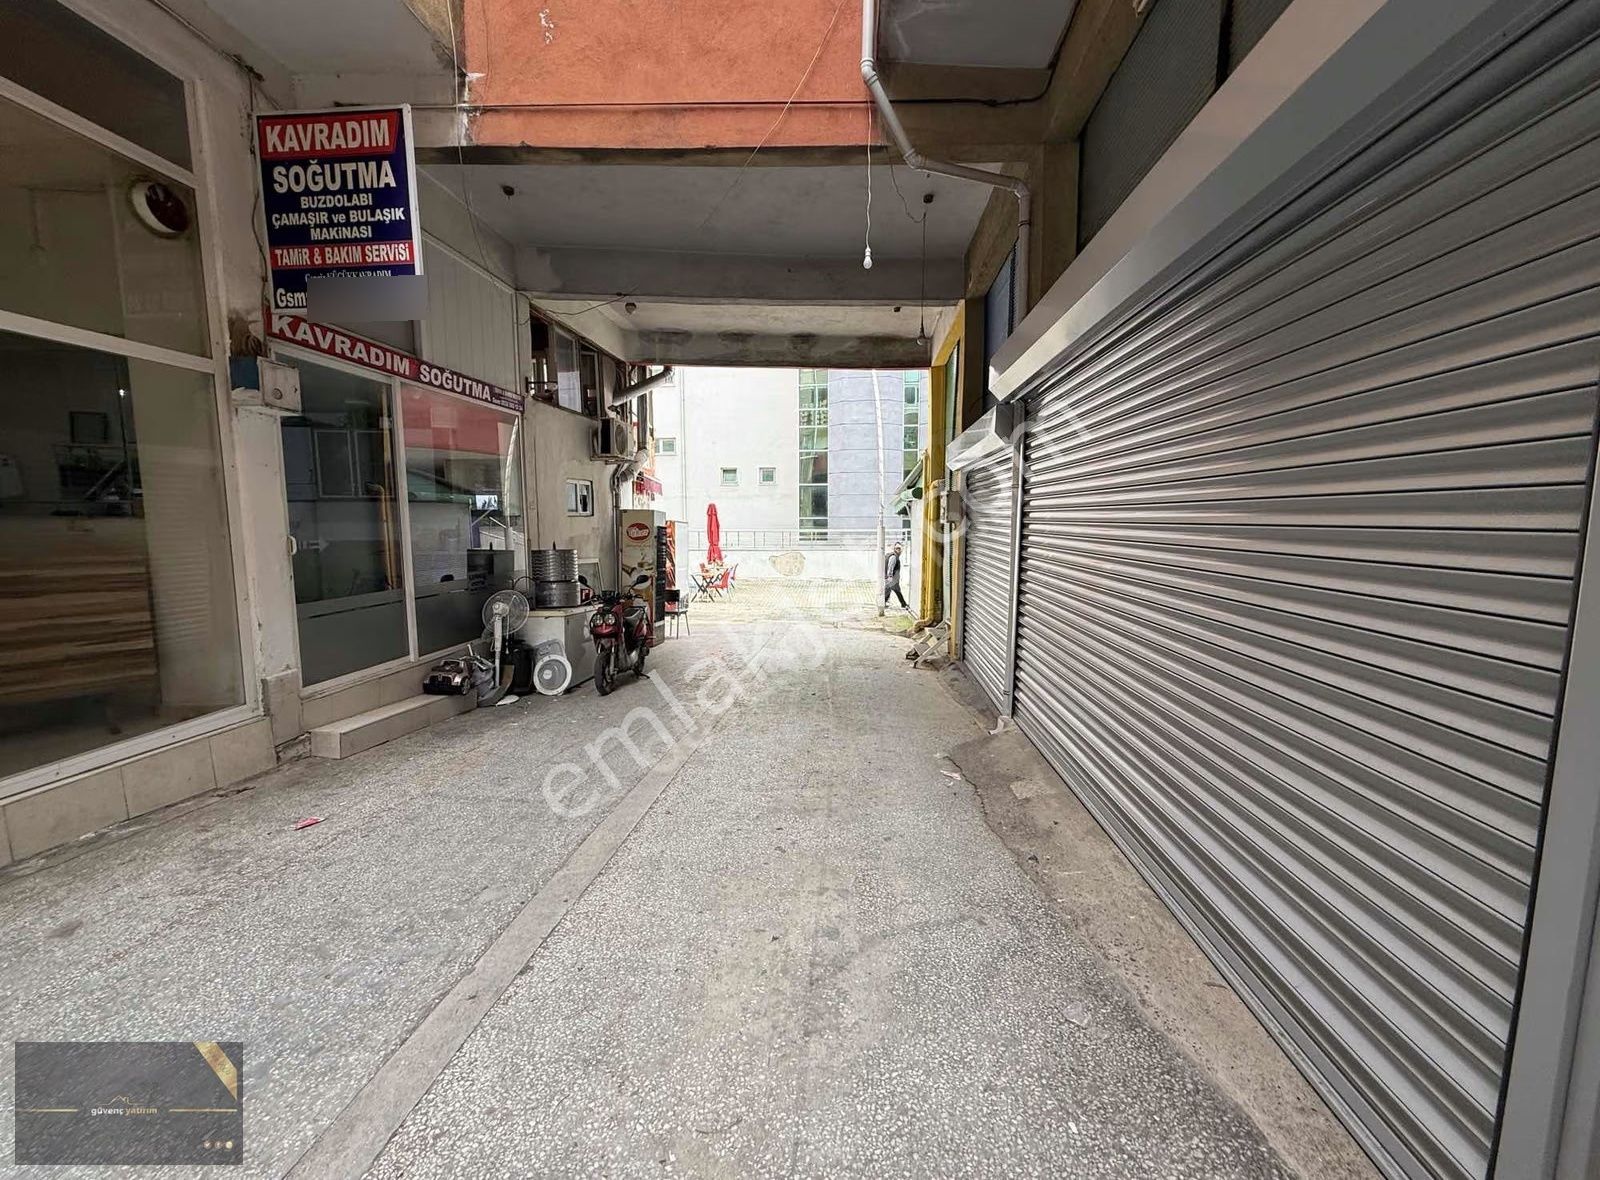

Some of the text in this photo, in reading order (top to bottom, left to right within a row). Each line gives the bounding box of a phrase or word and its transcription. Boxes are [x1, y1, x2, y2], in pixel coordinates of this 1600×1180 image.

[265, 119, 390, 152] KAVRADIM
[273, 159, 397, 193] SOĞUTMA
[301, 193, 373, 208] BUZDOLABI
[272, 208, 405, 229] ÇAMAŞIR ve BULAŞIK
[314, 248, 322, 265] &
[325, 245, 362, 264] BAKIM
[271, 314, 492, 401] KAVRADIM SOĞUTMA
